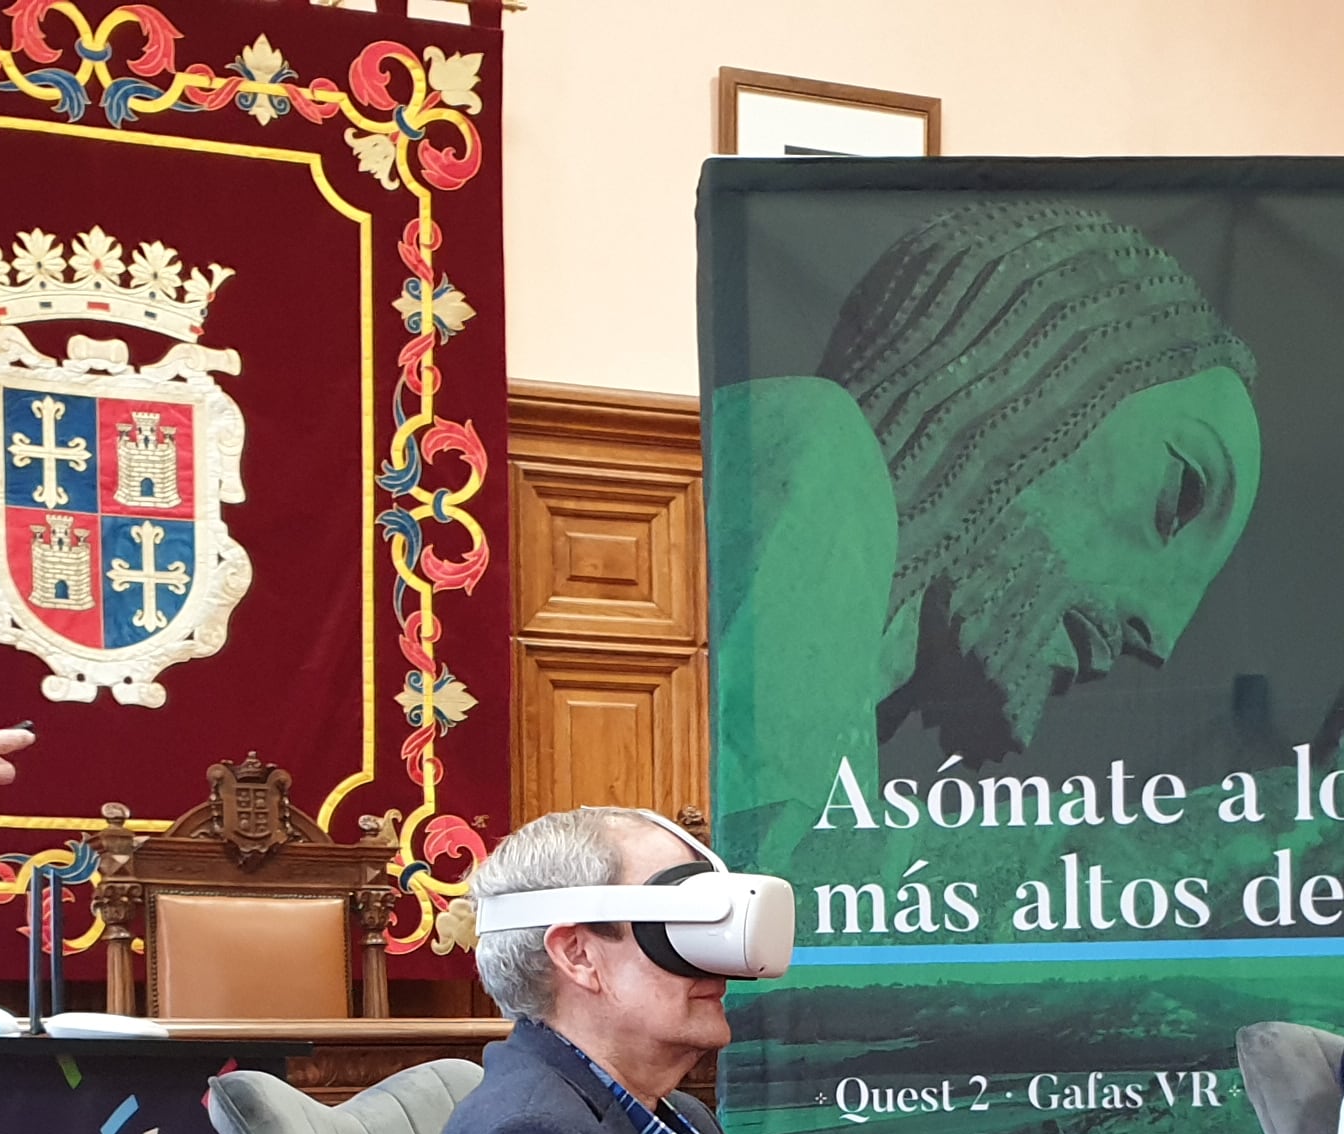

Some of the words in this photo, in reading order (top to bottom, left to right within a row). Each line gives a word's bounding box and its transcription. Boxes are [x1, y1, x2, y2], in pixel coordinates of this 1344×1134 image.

[812, 754, 1187, 829] Asómate
[1218, 770, 1265, 823] a
[813, 859, 980, 934] más
[1012, 852, 1211, 931] altos
[835, 1076, 955, 1123] Quest
[968, 1075, 990, 1111] 2
[1027, 1072, 1144, 1110] Gafas
[1154, 1071, 1223, 1107] VR
